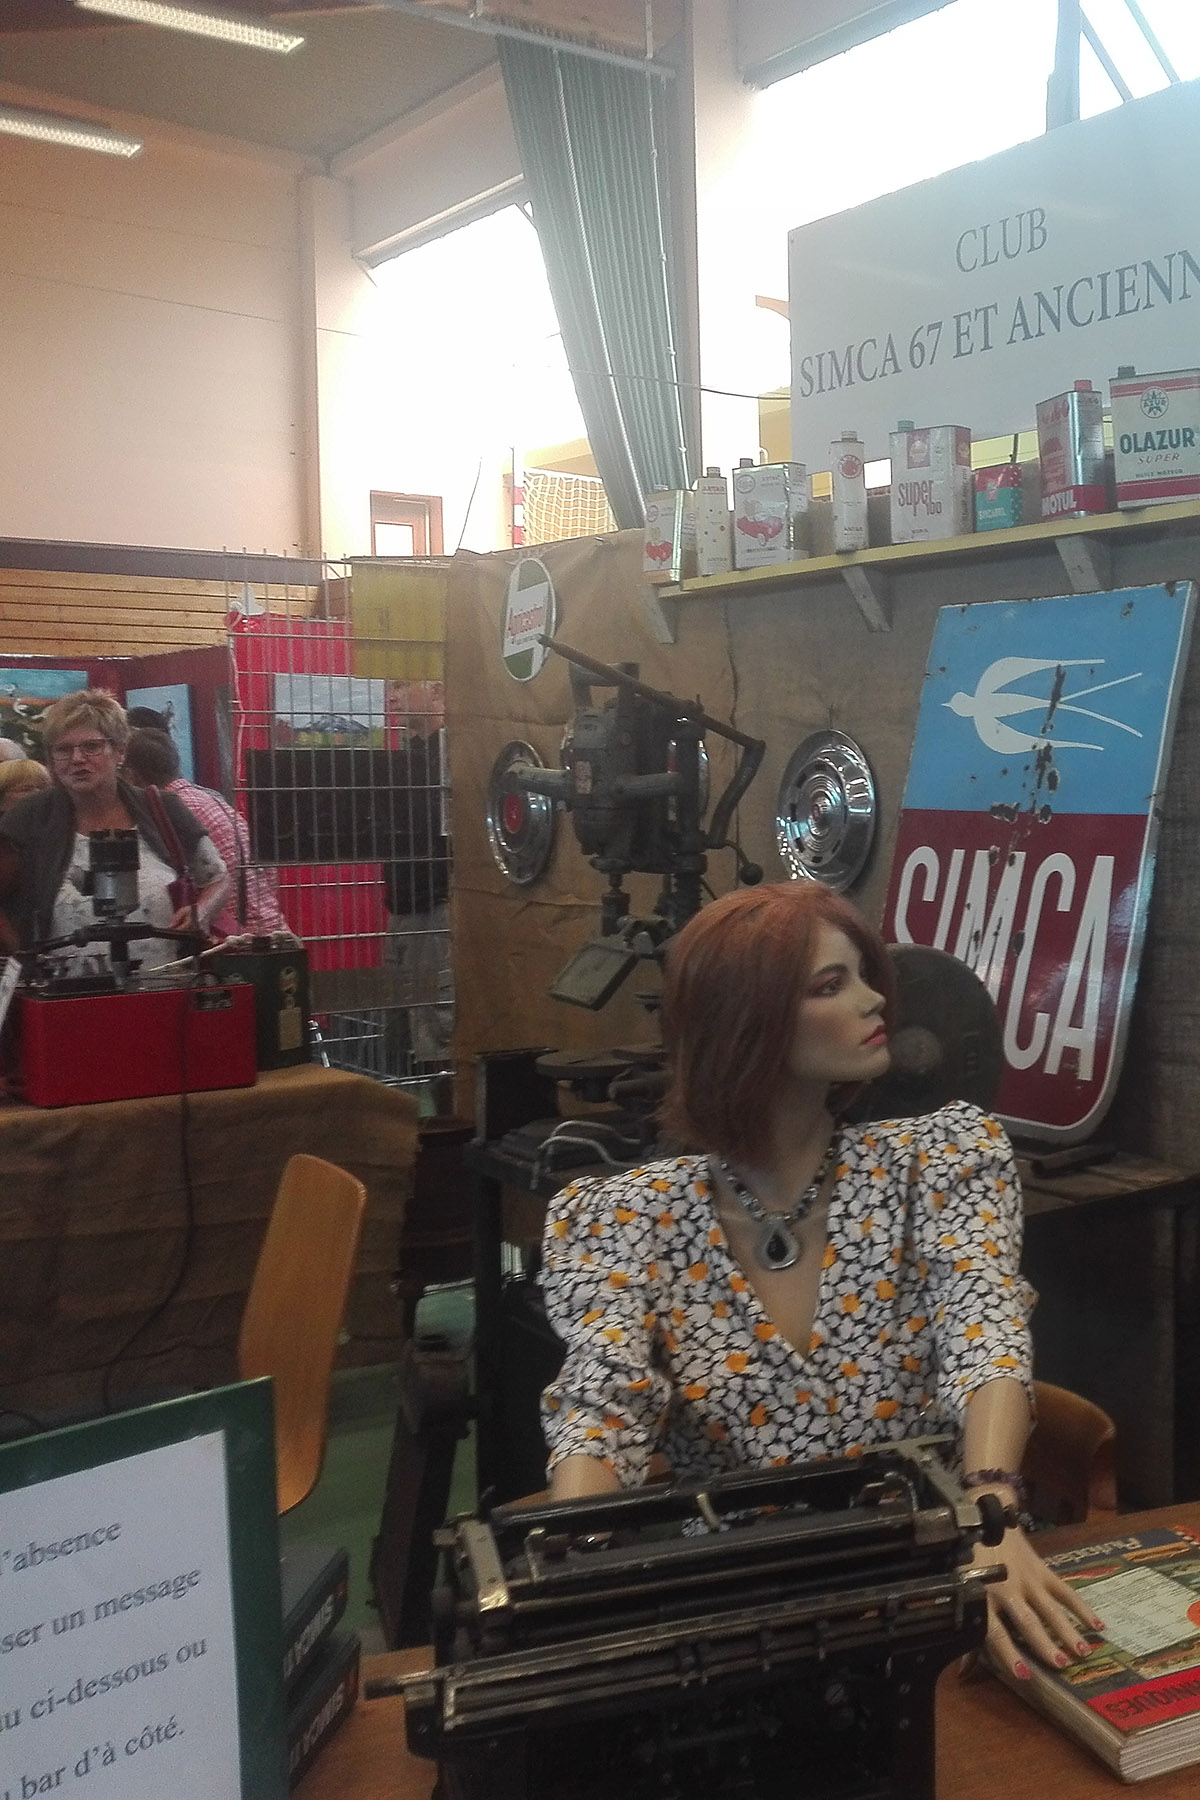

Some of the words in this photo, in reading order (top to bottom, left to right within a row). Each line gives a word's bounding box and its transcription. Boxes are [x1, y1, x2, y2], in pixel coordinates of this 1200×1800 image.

[955, 206, 1048, 273] CLUB
[799, 331, 902, 399] SIMCA
[908, 320, 944, 369] 67
[952, 302, 1000, 359] ET
[1119, 427, 1196, 454] OLAZUR
[1136, 453, 1181, 465] SUPER
[898, 478, 935, 517] super
[1041, 489, 1078, 517] MOTUL
[0, 1521, 122, 1577] 'absence
[51, 1608, 86, 1636] un
[93, 1567, 201, 1621] message
[29, 1650, 169, 1719] ci-dessous
[175, 1637, 208, 1661] ou
[20, 1766, 66, 1800] bar
[124, 1715, 186, 1756] côté.
